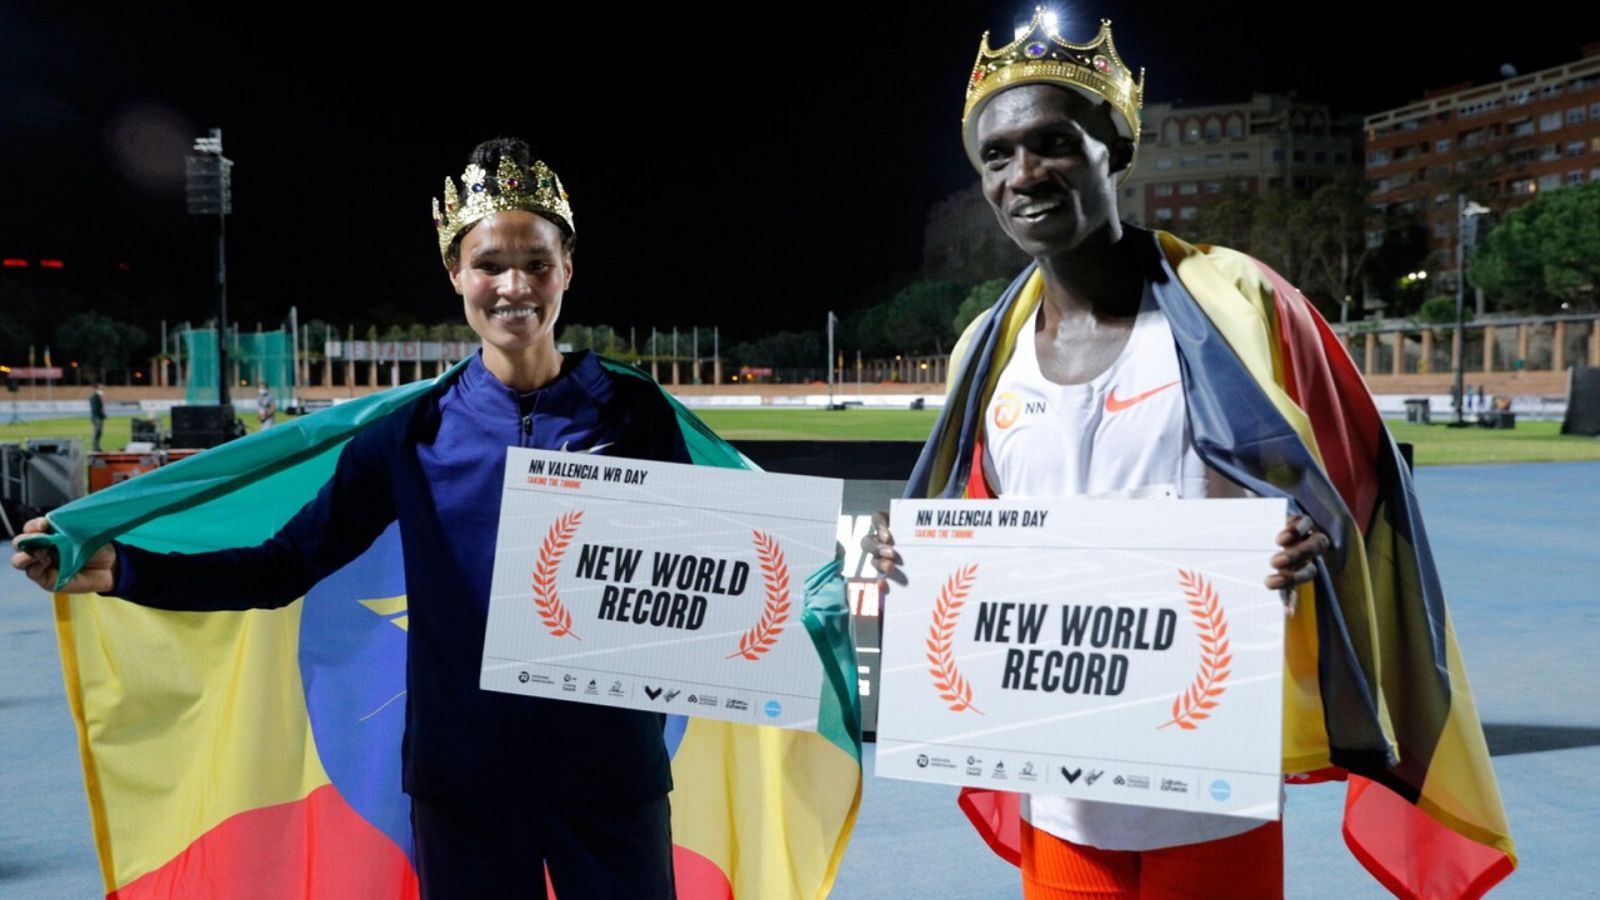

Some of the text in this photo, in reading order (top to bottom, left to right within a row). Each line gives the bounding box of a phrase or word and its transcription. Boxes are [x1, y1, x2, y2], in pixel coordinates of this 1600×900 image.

[1024, 401, 1047, 414] NN
[528, 459, 648, 485] NN VALENCIA WR DAY
[916, 510, 1048, 527] NN VALENCIA WR DAY
[575, 544, 750, 596] NEW WORLD
[597, 585, 708, 631] RECORD
[974, 602, 1177, 651] NEW WORLD
[1002, 649, 1129, 696] RECORD
